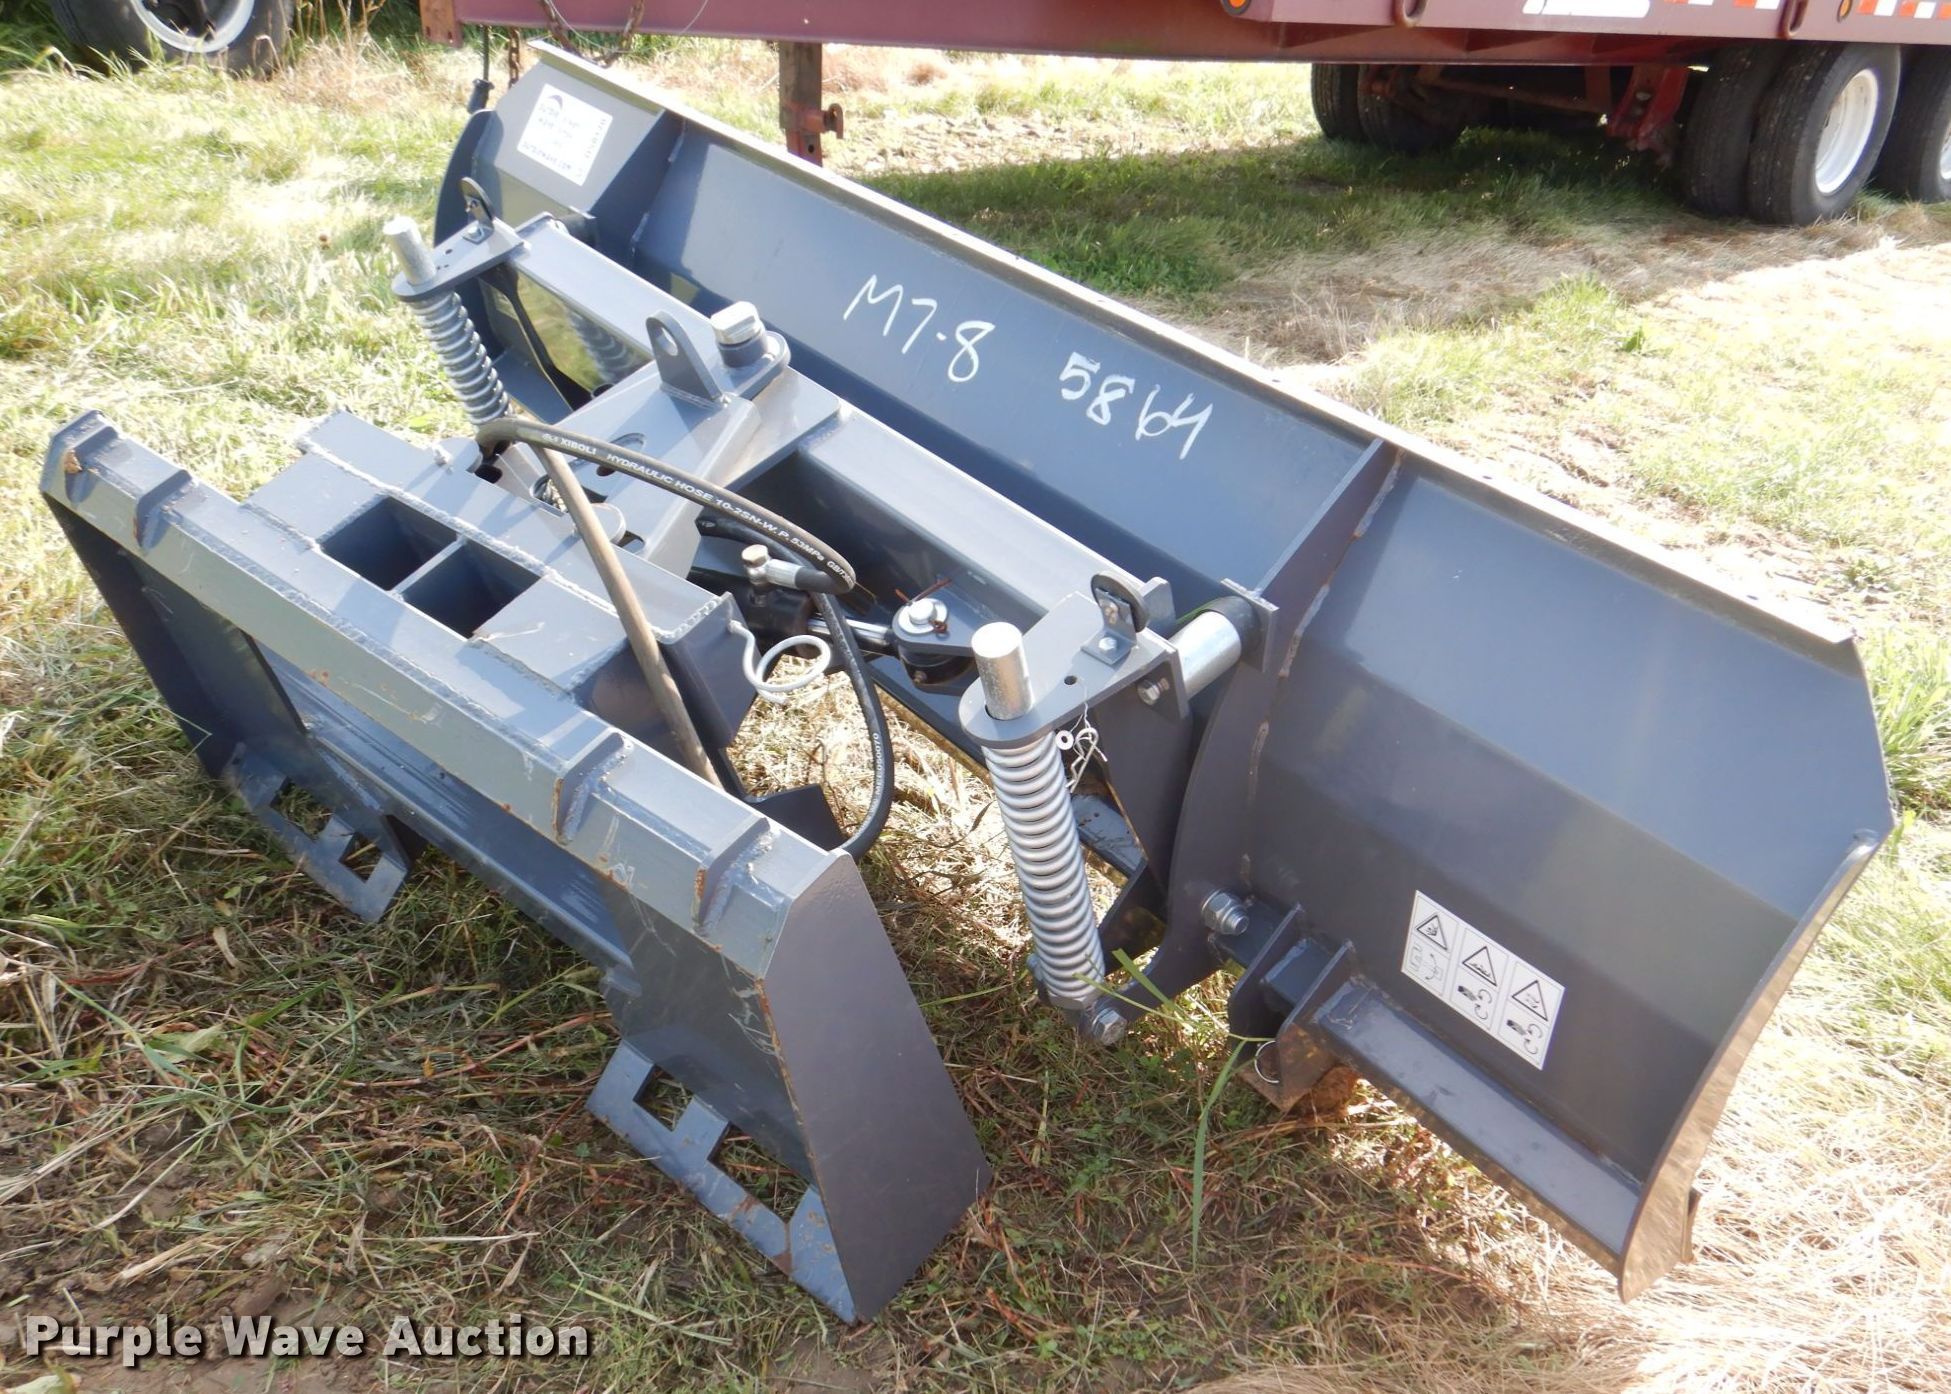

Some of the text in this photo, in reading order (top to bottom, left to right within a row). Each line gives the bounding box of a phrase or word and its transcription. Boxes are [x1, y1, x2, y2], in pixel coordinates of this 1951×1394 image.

[843, 274, 1214, 461] M7-8 5864
[606, 453, 674, 484] HYDRAULIC
[674, 480, 714, 501] HOSE
